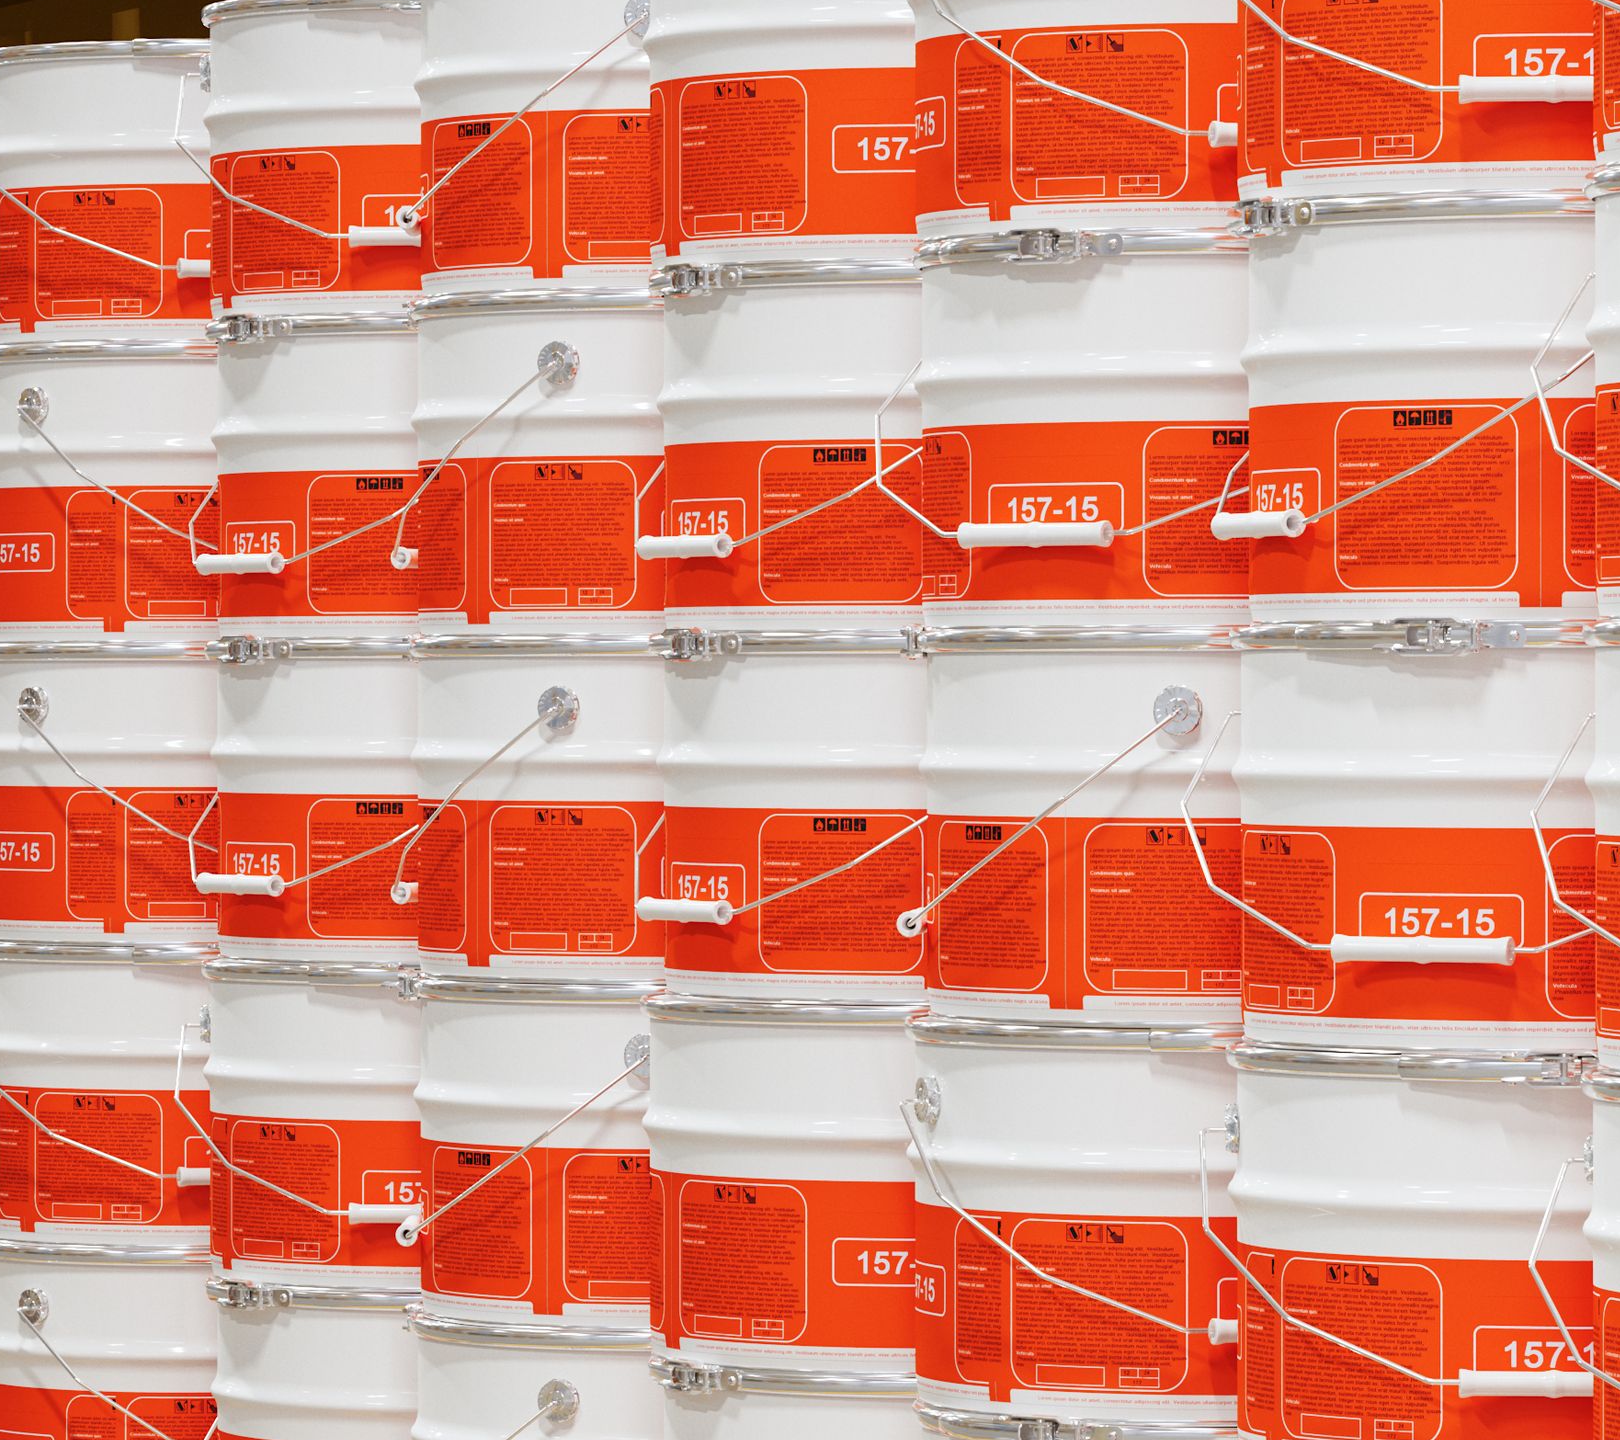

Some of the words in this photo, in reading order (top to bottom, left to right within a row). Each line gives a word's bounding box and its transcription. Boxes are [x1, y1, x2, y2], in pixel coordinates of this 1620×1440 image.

[1502, 49, 1594, 76] 157-1
[857, 137, 915, 160] 157-
[1008, 497, 1099, 522] 157-15
[1256, 483, 1304, 511] 157-15
[679, 511, 728, 534] 157-15
[233, 532, 280, 553] 157-15
[233, 853, 280, 875] 157-15
[679, 874, 728, 899] 157-15
[1385, 908, 1495, 936] 157-15
[857, 1251, 915, 1275] 157-
[1504, 1341, 1594, 1368] 157-1
